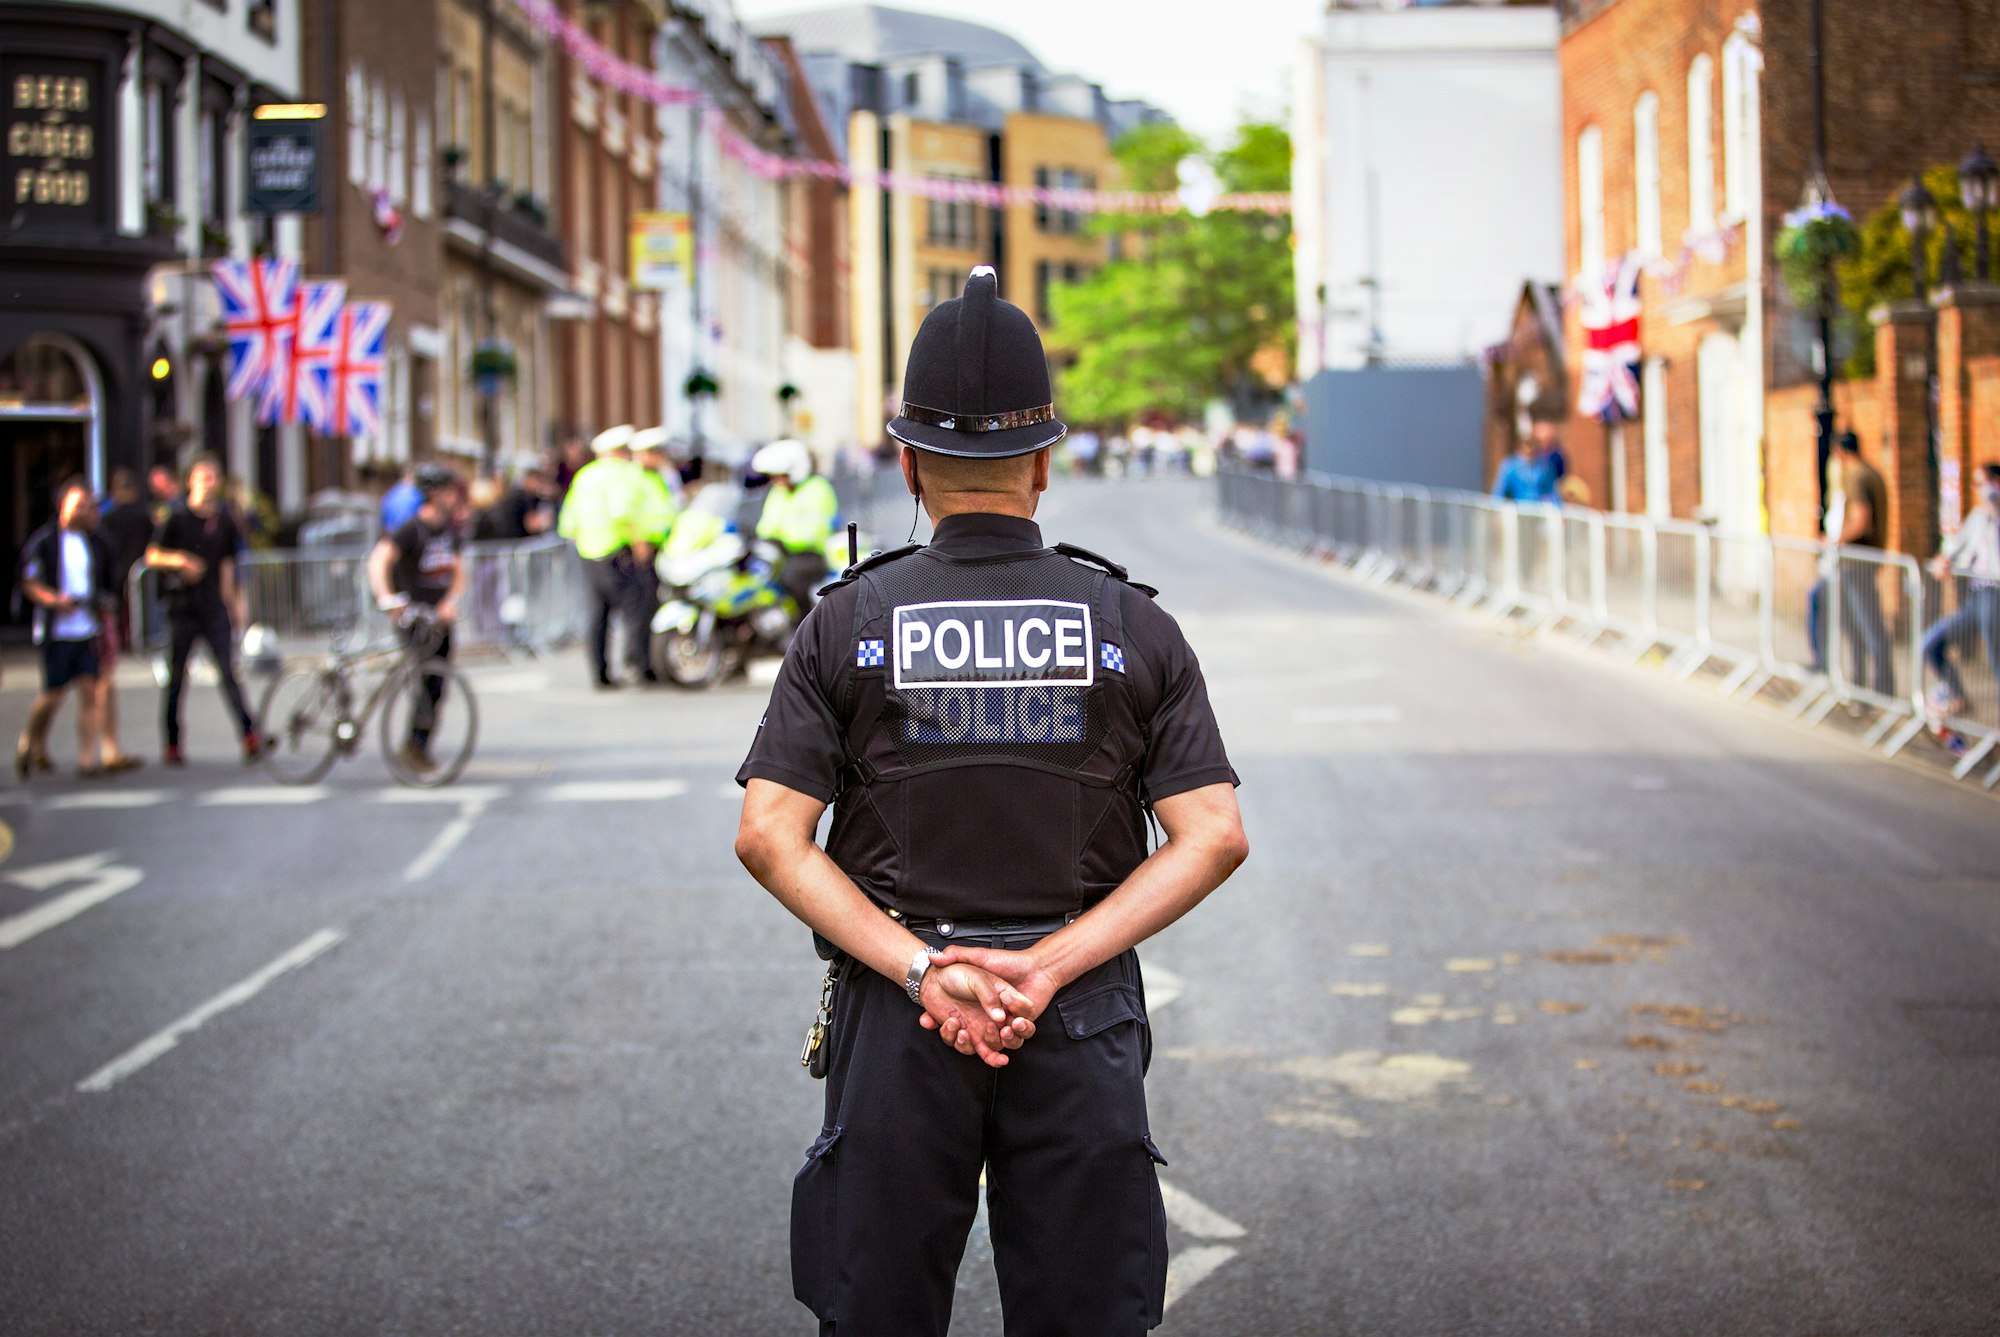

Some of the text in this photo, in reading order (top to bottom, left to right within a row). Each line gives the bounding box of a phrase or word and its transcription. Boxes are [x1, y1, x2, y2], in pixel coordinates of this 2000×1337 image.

[13, 75, 89, 111] BEER
[8, 122, 93, 159] CIDER
[15, 168, 90, 205] FOOD
[901, 618, 1085, 670] POLICE
[904, 687, 1081, 739] POLICE
